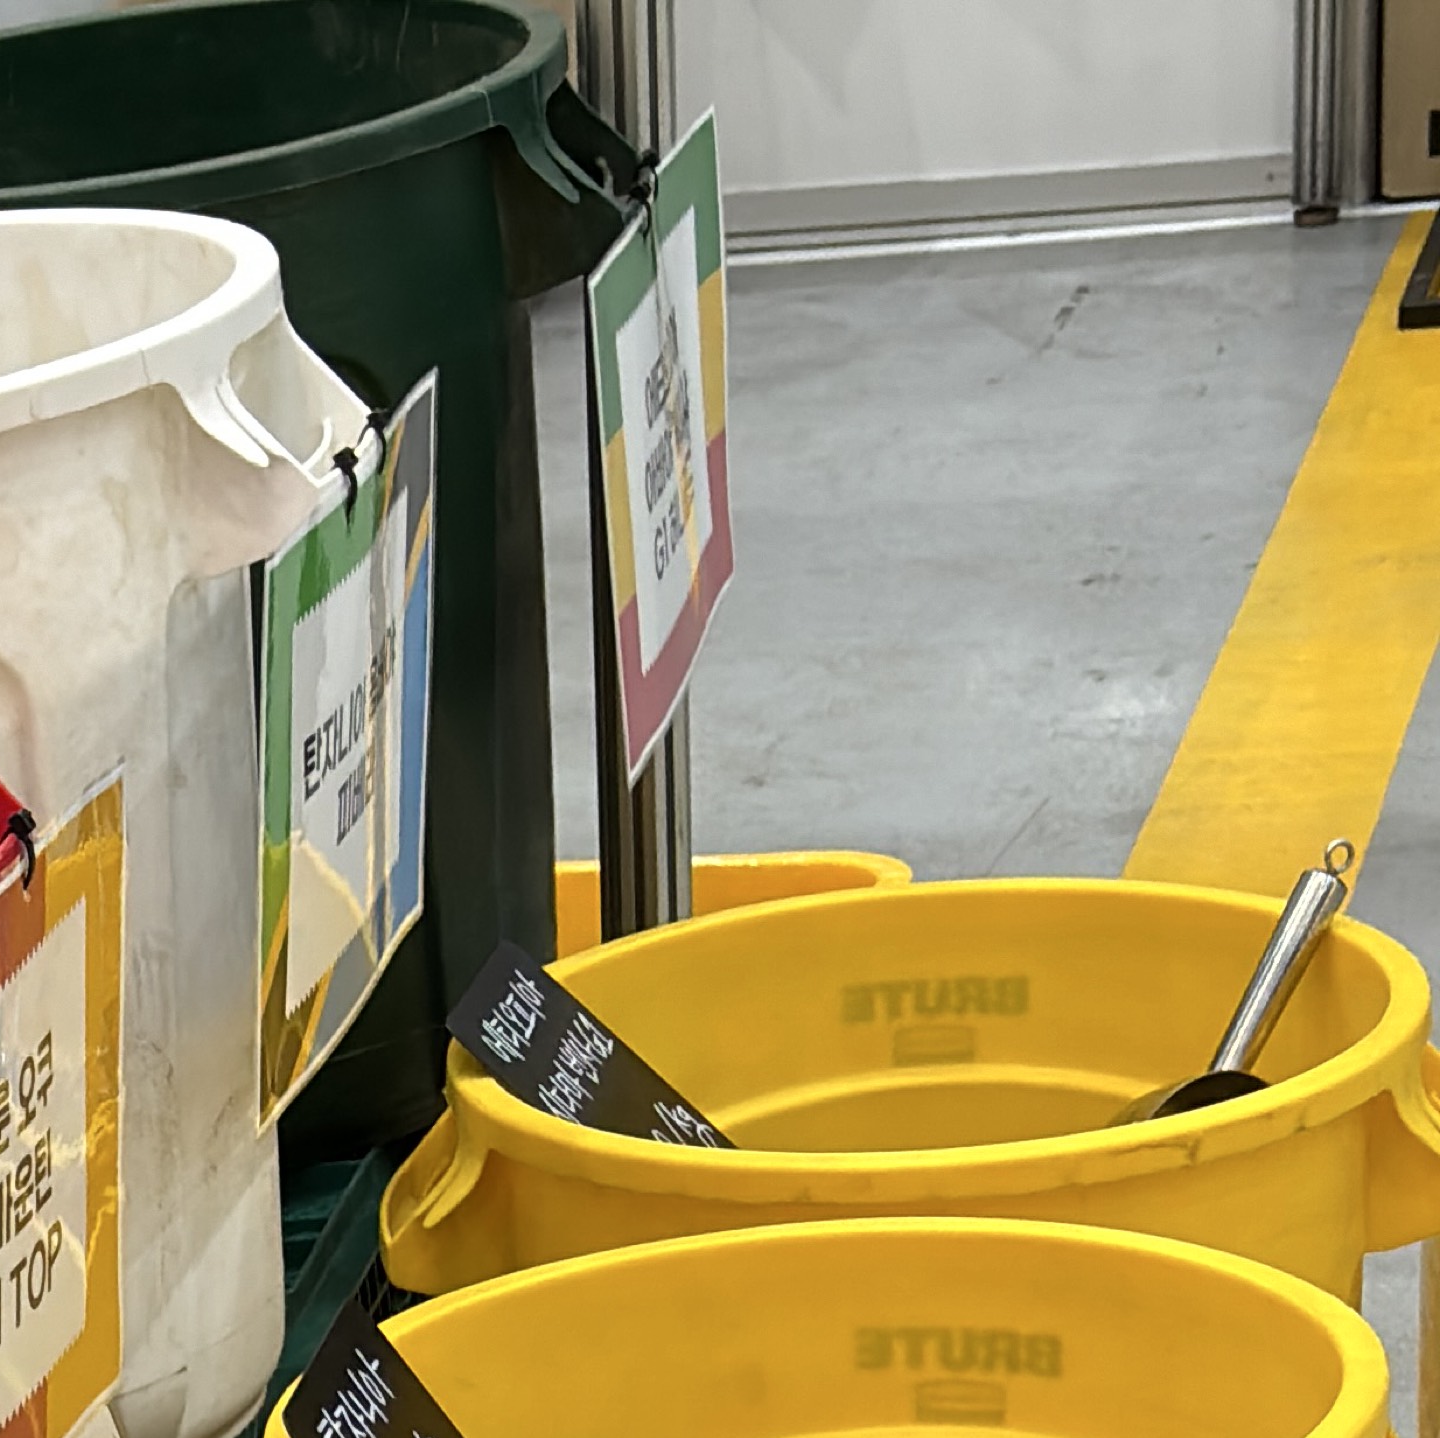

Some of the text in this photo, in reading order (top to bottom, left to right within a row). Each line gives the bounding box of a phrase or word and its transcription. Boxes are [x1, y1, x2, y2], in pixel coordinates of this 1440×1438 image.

[303, 672, 366, 803] 탄자니아
[480, 969, 547, 1063] 에티오피아
[17, 1030, 54, 1136] 오쿠
[10, 1217, 62, 1328] TOP
